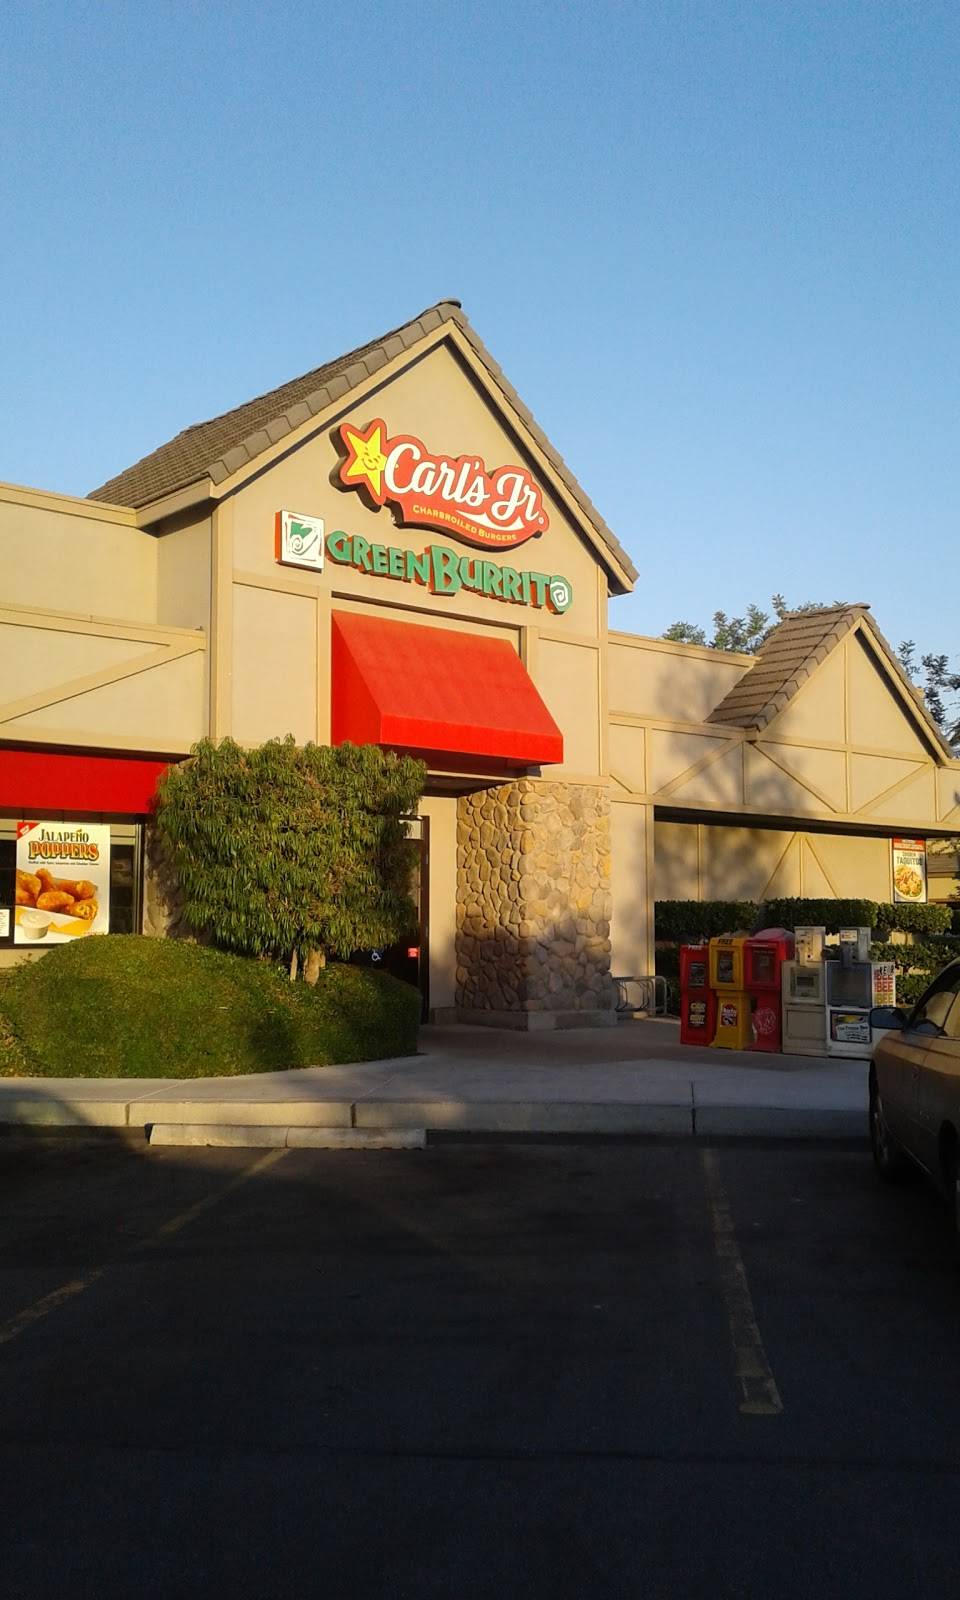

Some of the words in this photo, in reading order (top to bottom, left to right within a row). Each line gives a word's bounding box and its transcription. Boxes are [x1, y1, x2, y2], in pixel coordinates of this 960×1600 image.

[385, 443, 490, 507] Carl's
[412, 505, 477, 534] CHARBROILED
[478, 528, 517, 541] BURGERS
[28, 841, 100, 861] POPPERS
